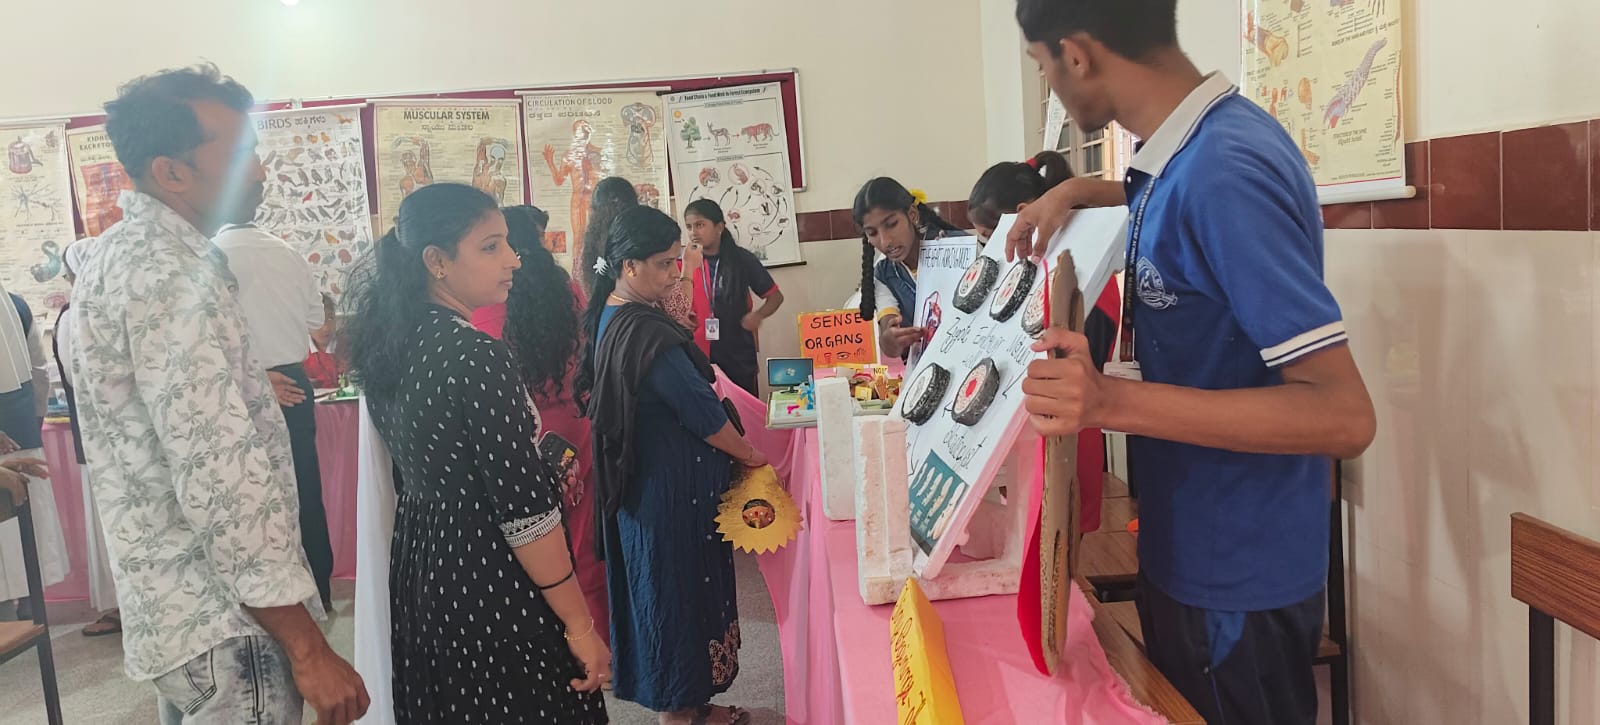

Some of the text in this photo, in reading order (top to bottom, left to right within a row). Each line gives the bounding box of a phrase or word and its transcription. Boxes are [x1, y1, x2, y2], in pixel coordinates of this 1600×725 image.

[527, 98, 576, 107] CIRCULATION
[588, 97, 613, 105] BLOOD
[403, 111, 490, 120] MUSCULAR SYSTEM
[257, 118, 292, 130] BIRDS
[810, 312, 862, 329] SENSE
[805, 333, 863, 350] ORGANS
